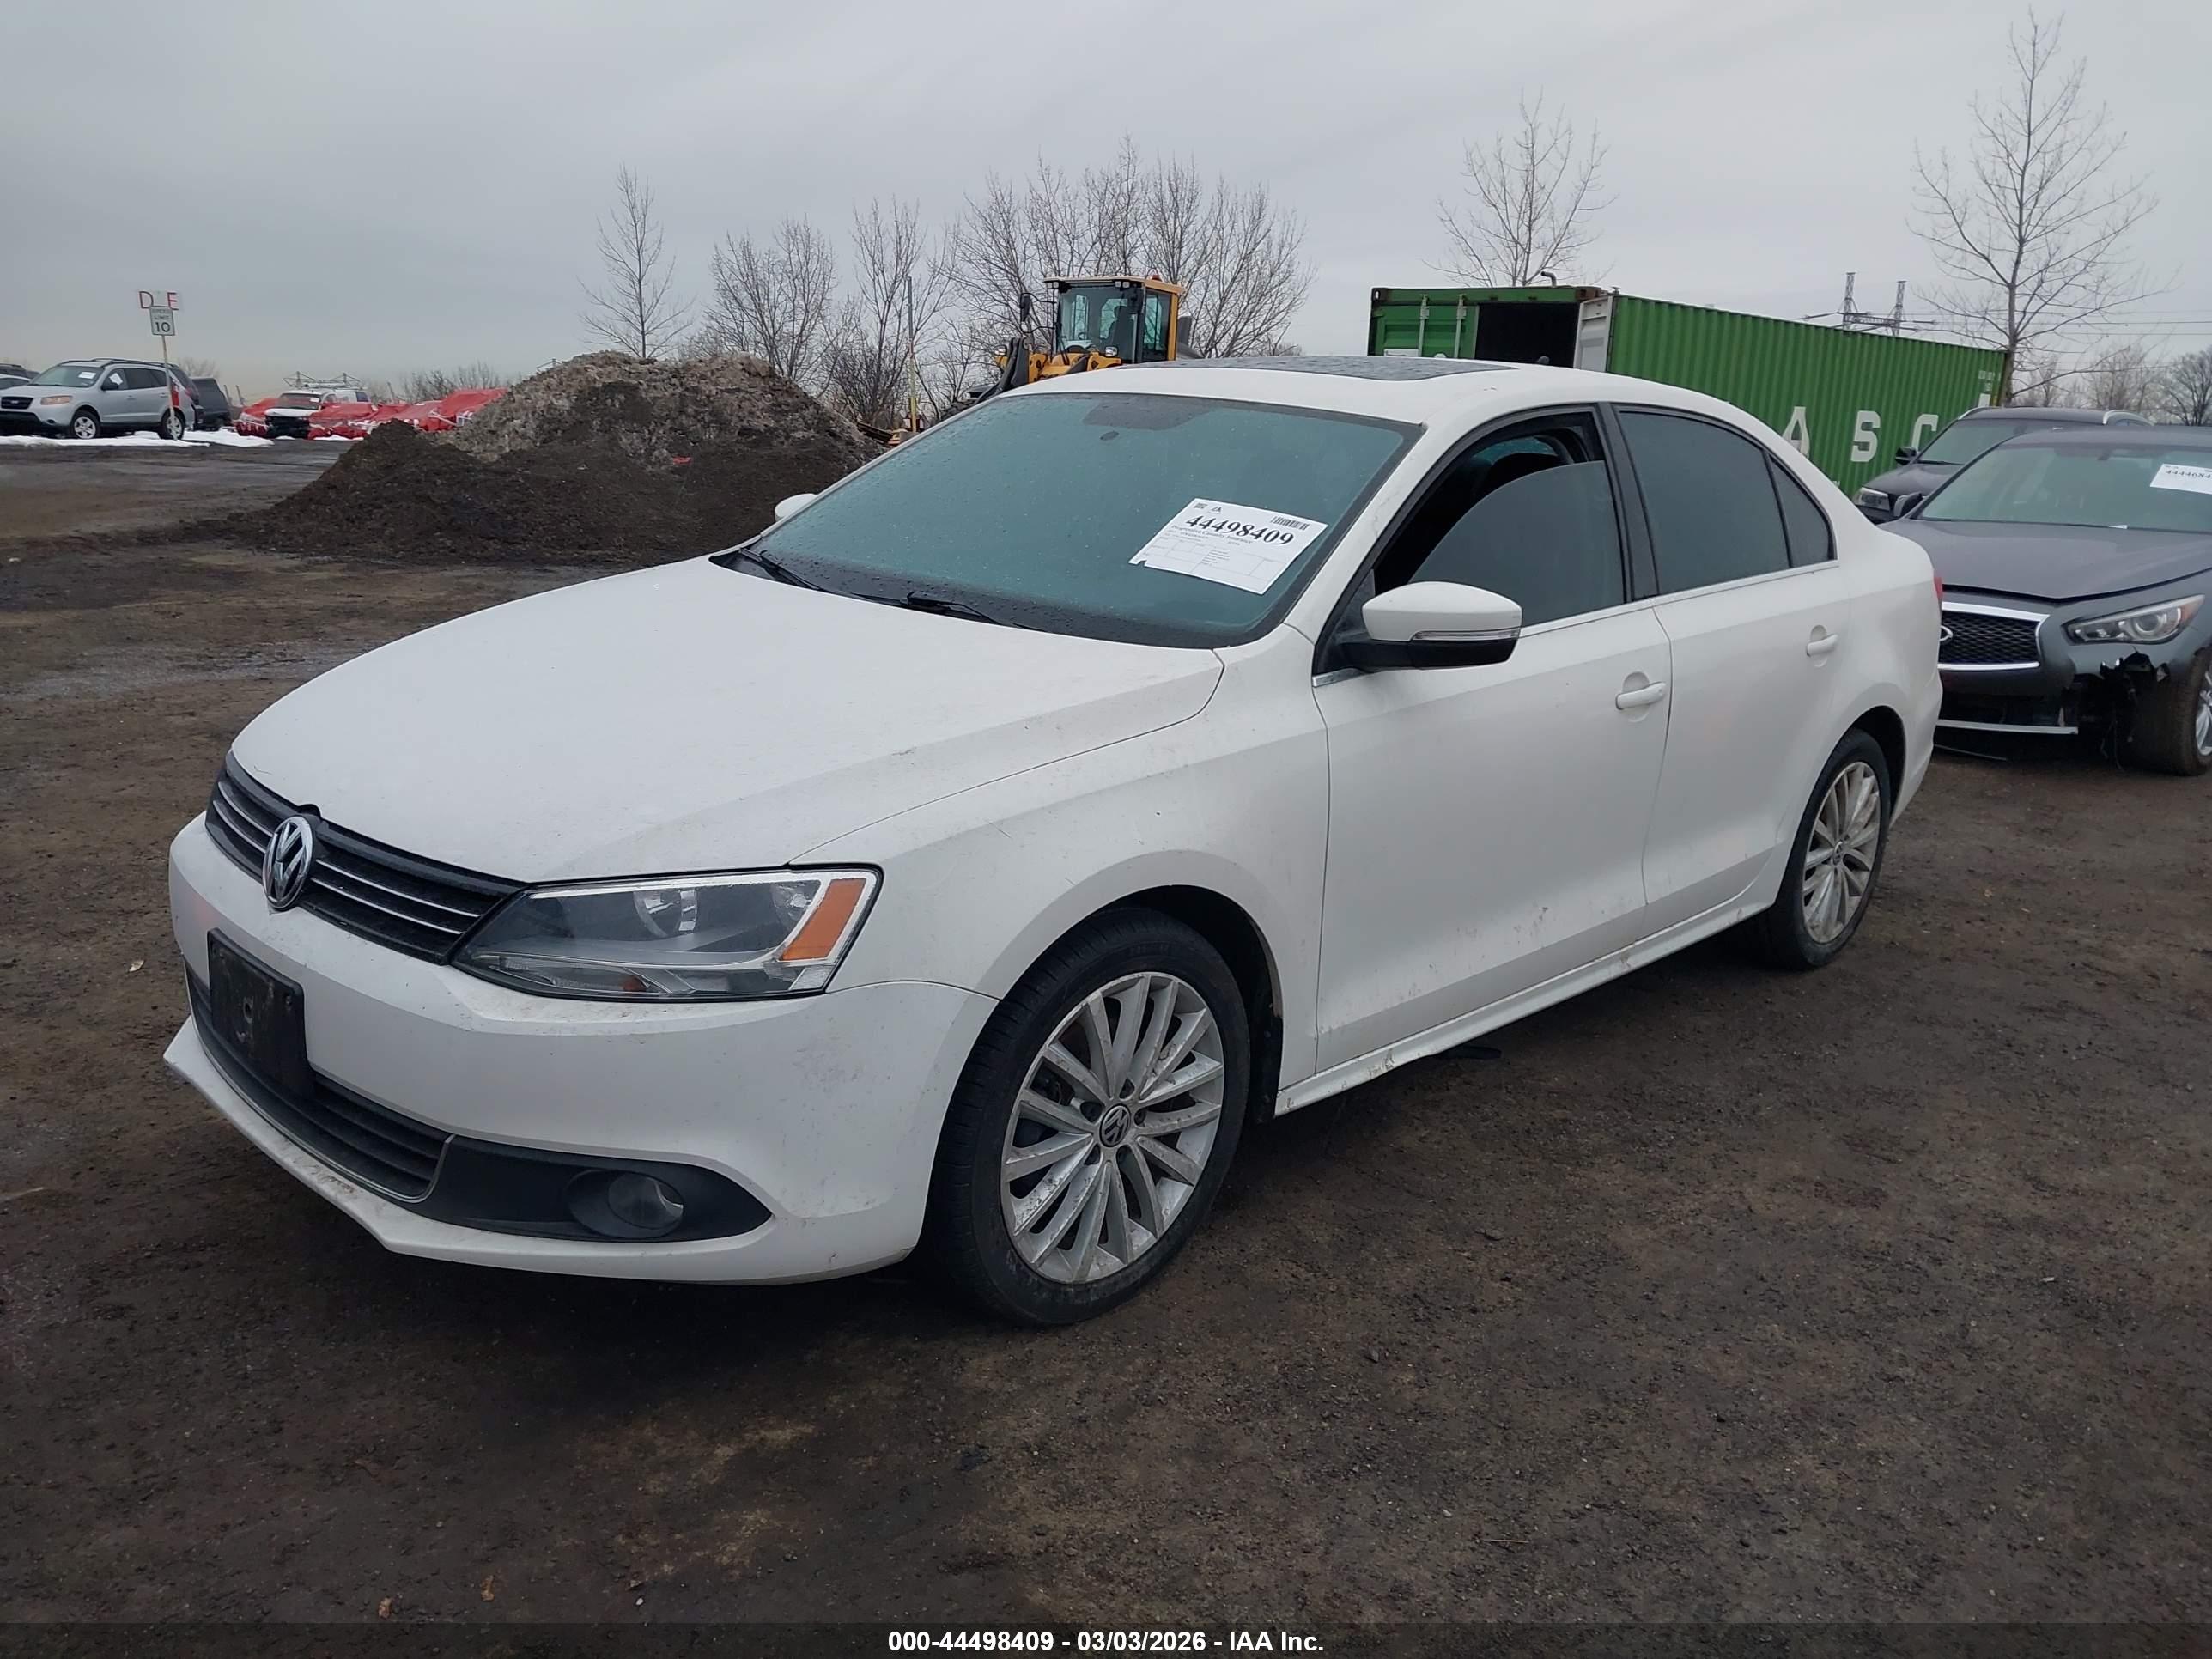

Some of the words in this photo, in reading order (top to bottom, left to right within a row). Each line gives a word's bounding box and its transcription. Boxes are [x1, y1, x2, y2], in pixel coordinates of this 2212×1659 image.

[139, 291, 155, 309] D
[167, 292, 179, 311] E
[155, 321, 171, 332] 10
[1186, 514, 1295, 546] 44498409
